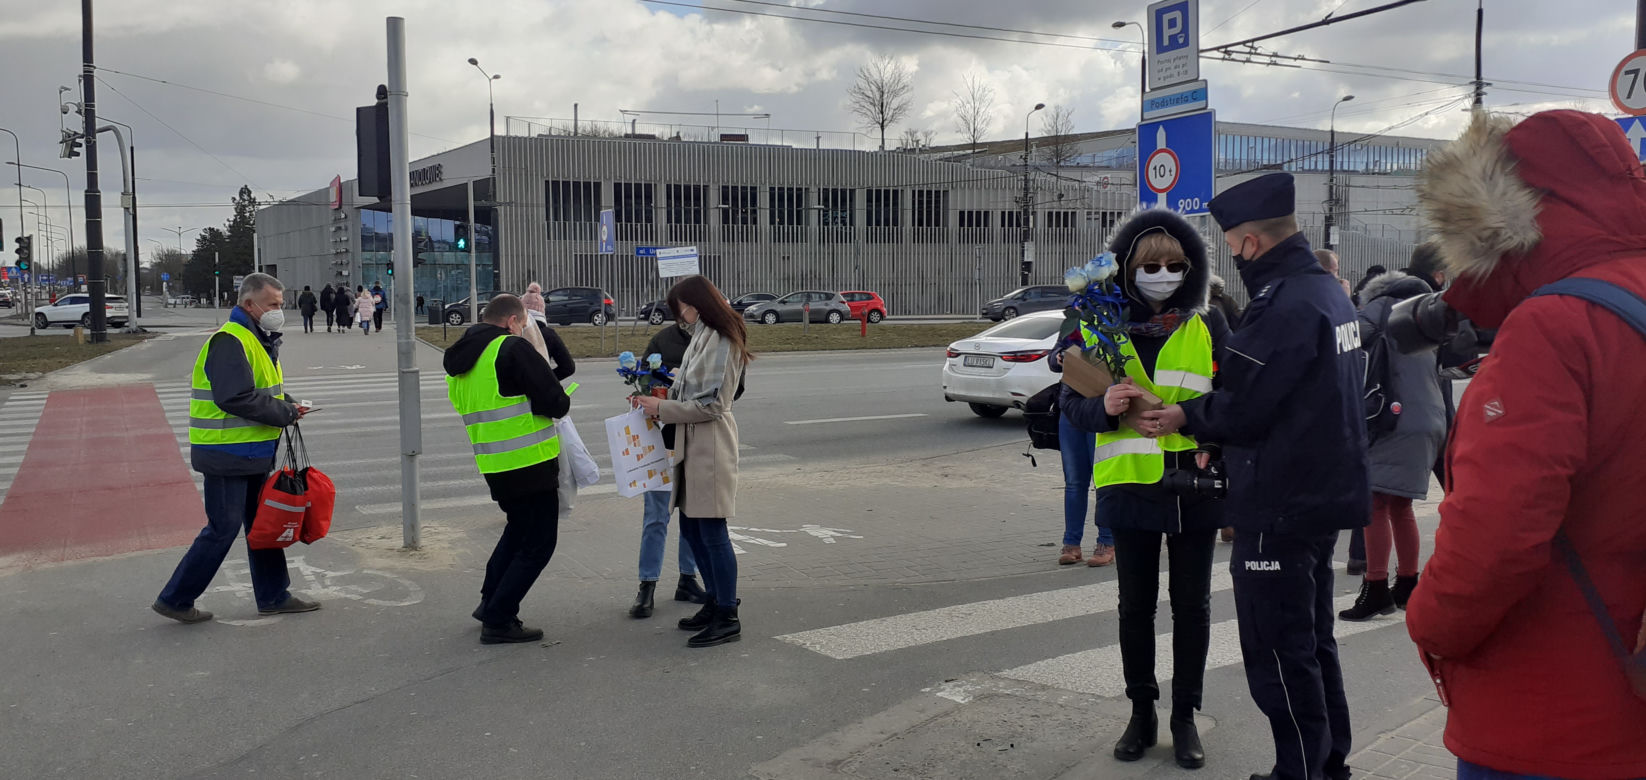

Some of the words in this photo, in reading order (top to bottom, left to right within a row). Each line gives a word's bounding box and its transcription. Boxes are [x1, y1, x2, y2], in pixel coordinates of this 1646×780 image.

[1162, 9, 1182, 46] P
[1624, 68, 1646, 100] 7
[1150, 94, 1189, 108] Podstrefa
[1191, 90, 1198, 100] C
[1152, 164, 1165, 179] 10
[1178, 197, 1200, 213] 900
[1335, 320, 1362, 355] POLICJ
[1245, 560, 1281, 571] POLICJA
